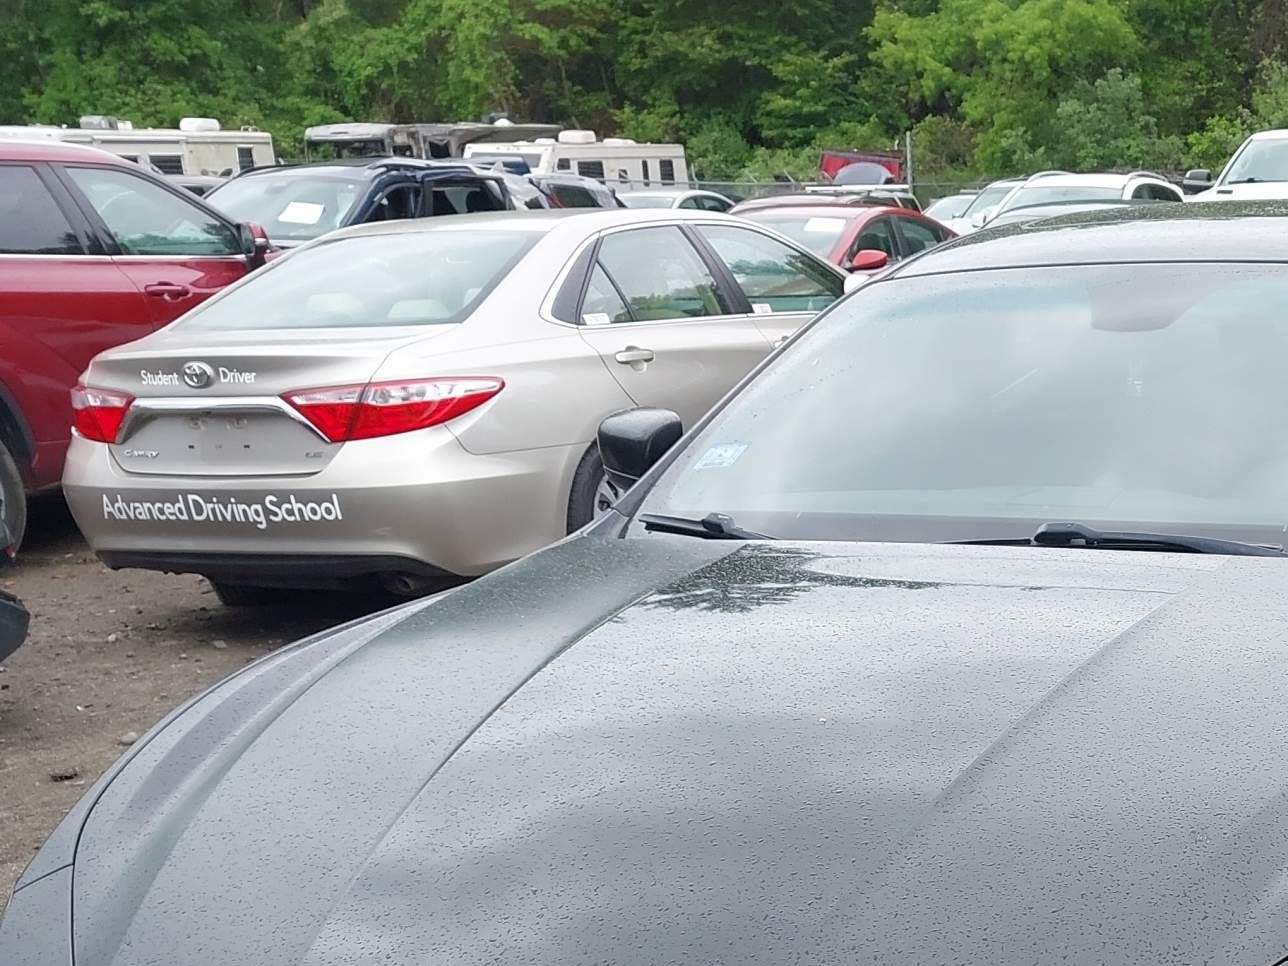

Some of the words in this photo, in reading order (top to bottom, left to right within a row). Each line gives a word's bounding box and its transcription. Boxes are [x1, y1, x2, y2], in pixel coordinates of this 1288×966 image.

[140, 369, 179, 386] Student
[218, 367, 256, 384] Driver
[102, 493, 188, 521] Advanced
[188, 494, 266, 530] Driving
[264, 493, 343, 521] School
